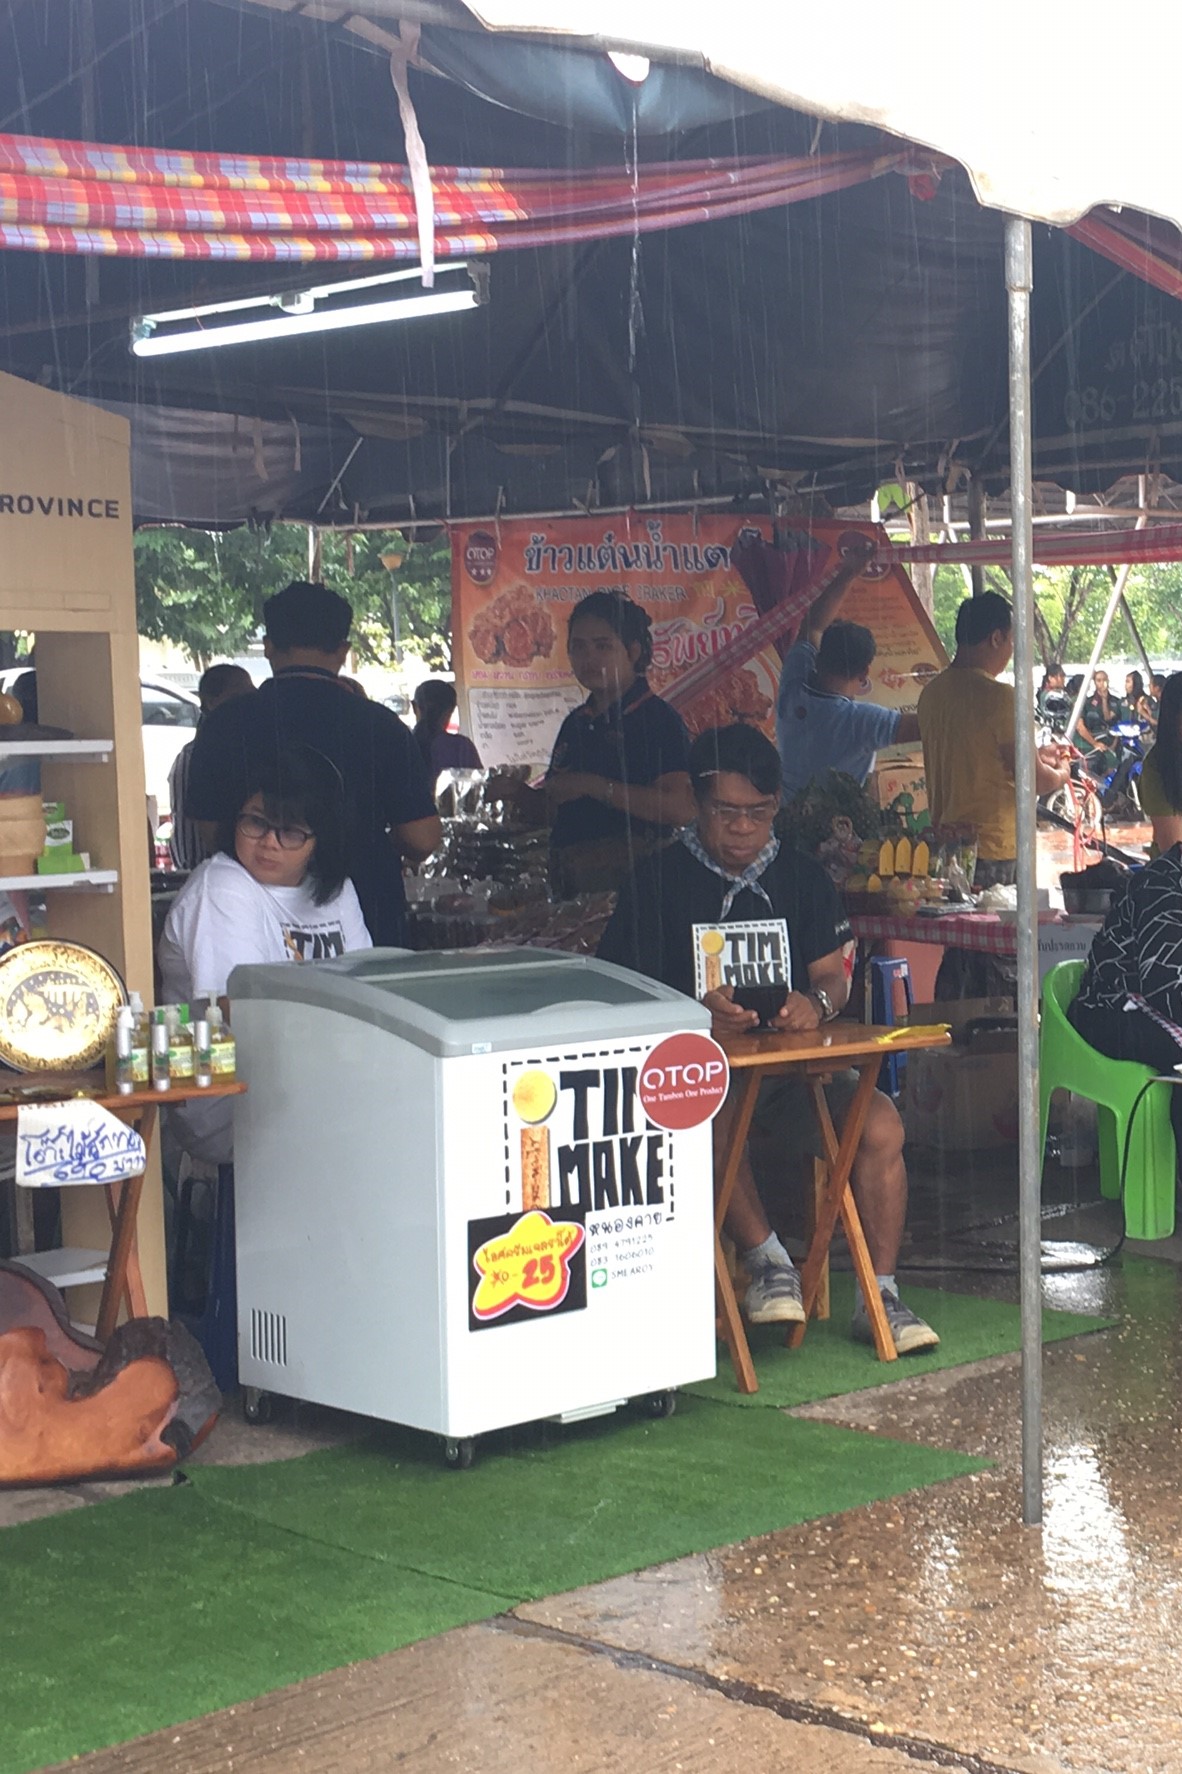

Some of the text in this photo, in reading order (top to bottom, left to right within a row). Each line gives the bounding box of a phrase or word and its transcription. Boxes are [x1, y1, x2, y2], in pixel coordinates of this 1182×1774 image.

[466, 545, 495, 561] OTOP
[523, 520, 761, 573] ข้าวแต๋นน้ำแต
[725, 931, 781, 964] TIM
[643, 1061, 723, 1090] OTOP
[685, 1089, 698, 1098] One
[557, 1133, 665, 1212] MAKE
[522, 1253, 556, 1289] 25
